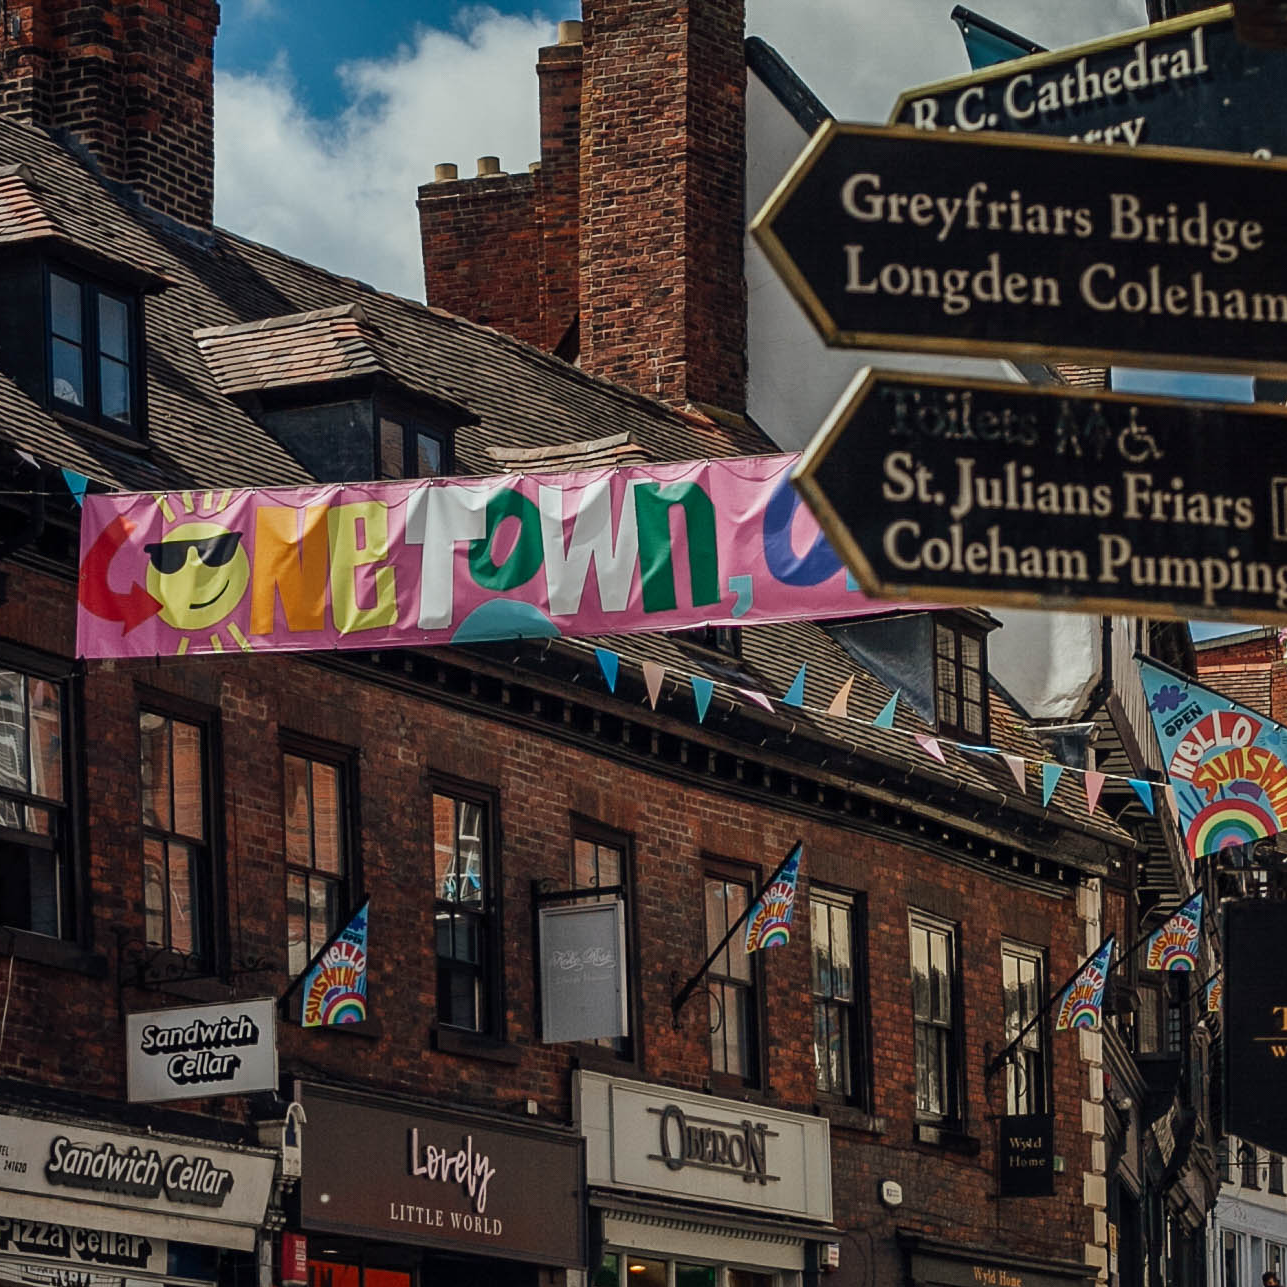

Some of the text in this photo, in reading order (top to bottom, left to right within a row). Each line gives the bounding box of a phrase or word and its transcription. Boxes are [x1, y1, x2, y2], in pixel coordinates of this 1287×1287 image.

[1004, 26, 1209, 120] Cathedral
[840, 173, 1264, 261] Greyfriars Bridge
[844, 245, 1061, 313] Longden
[881, 453, 944, 505] St.
[952, 459, 1113, 517] Julians
[1123, 473, 1255, 529] Friars
[881, 521, 1090, 582] Coleham
[1164, 703, 1204, 738] OPEN
[140, 1015, 259, 1053] Sandwich
[166, 1054, 241, 1085] Cellar
[47, 1137, 231, 1198] Sandwich Cellar
[412, 1127, 496, 1214] Lovely
[390, 1202, 502, 1236] LITTLE WORLD
